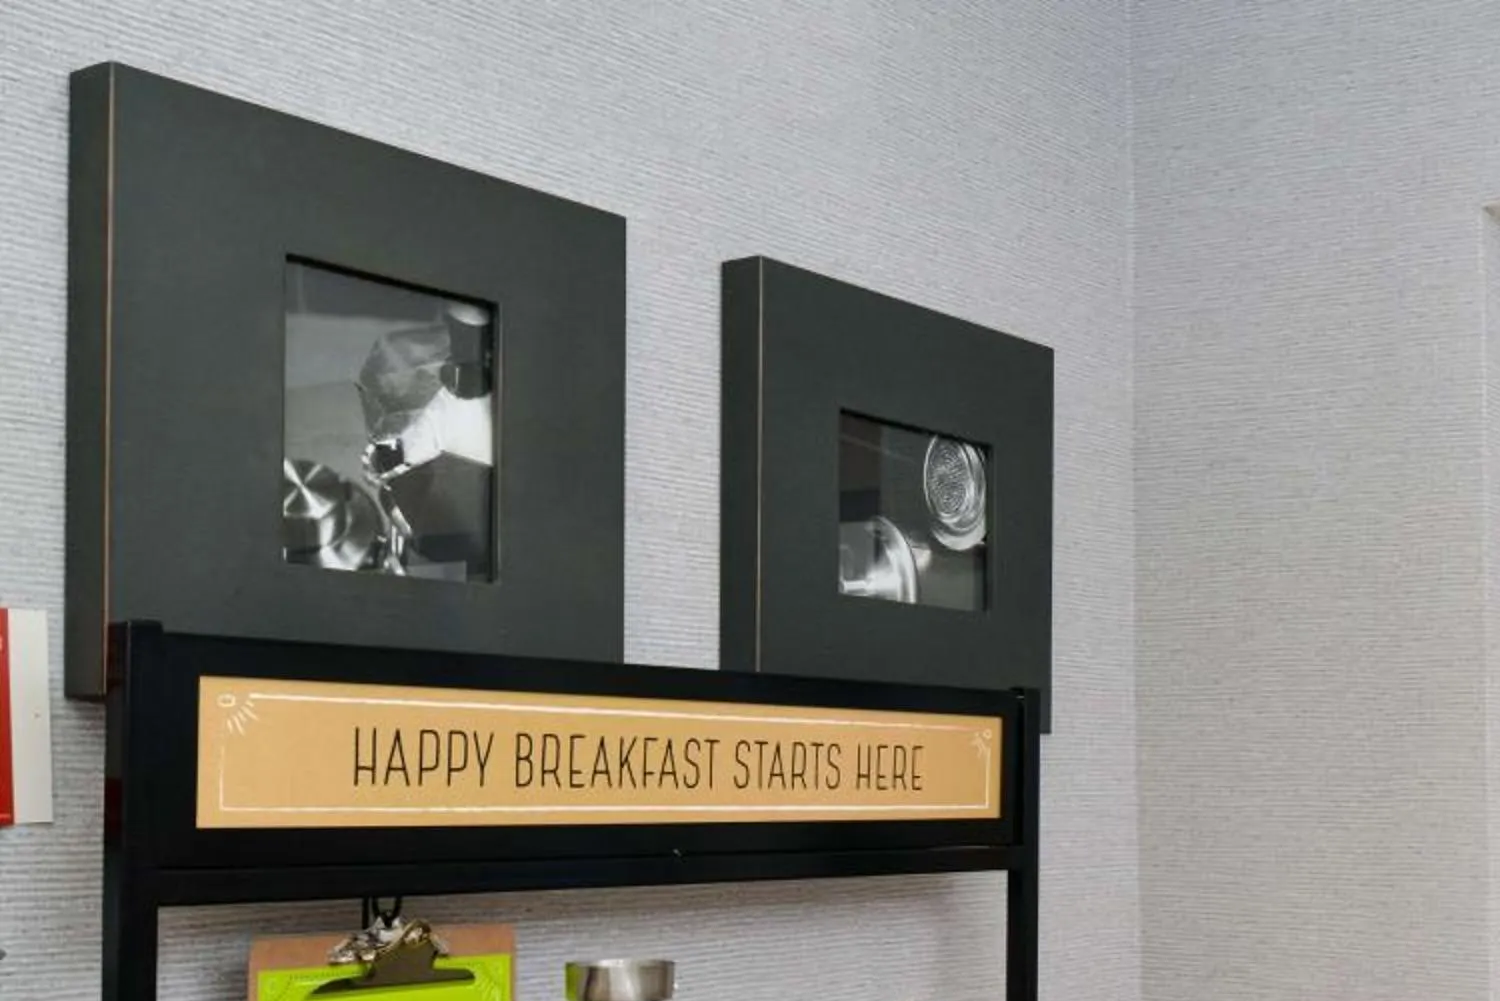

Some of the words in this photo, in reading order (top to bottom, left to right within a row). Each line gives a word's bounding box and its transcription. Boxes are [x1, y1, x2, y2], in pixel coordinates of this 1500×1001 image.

[353, 727, 494, 786] HAPPY
[515, 733, 720, 790] BREAKFAST
[733, 739, 842, 790] STARTS
[855, 743, 924, 791] HERE
